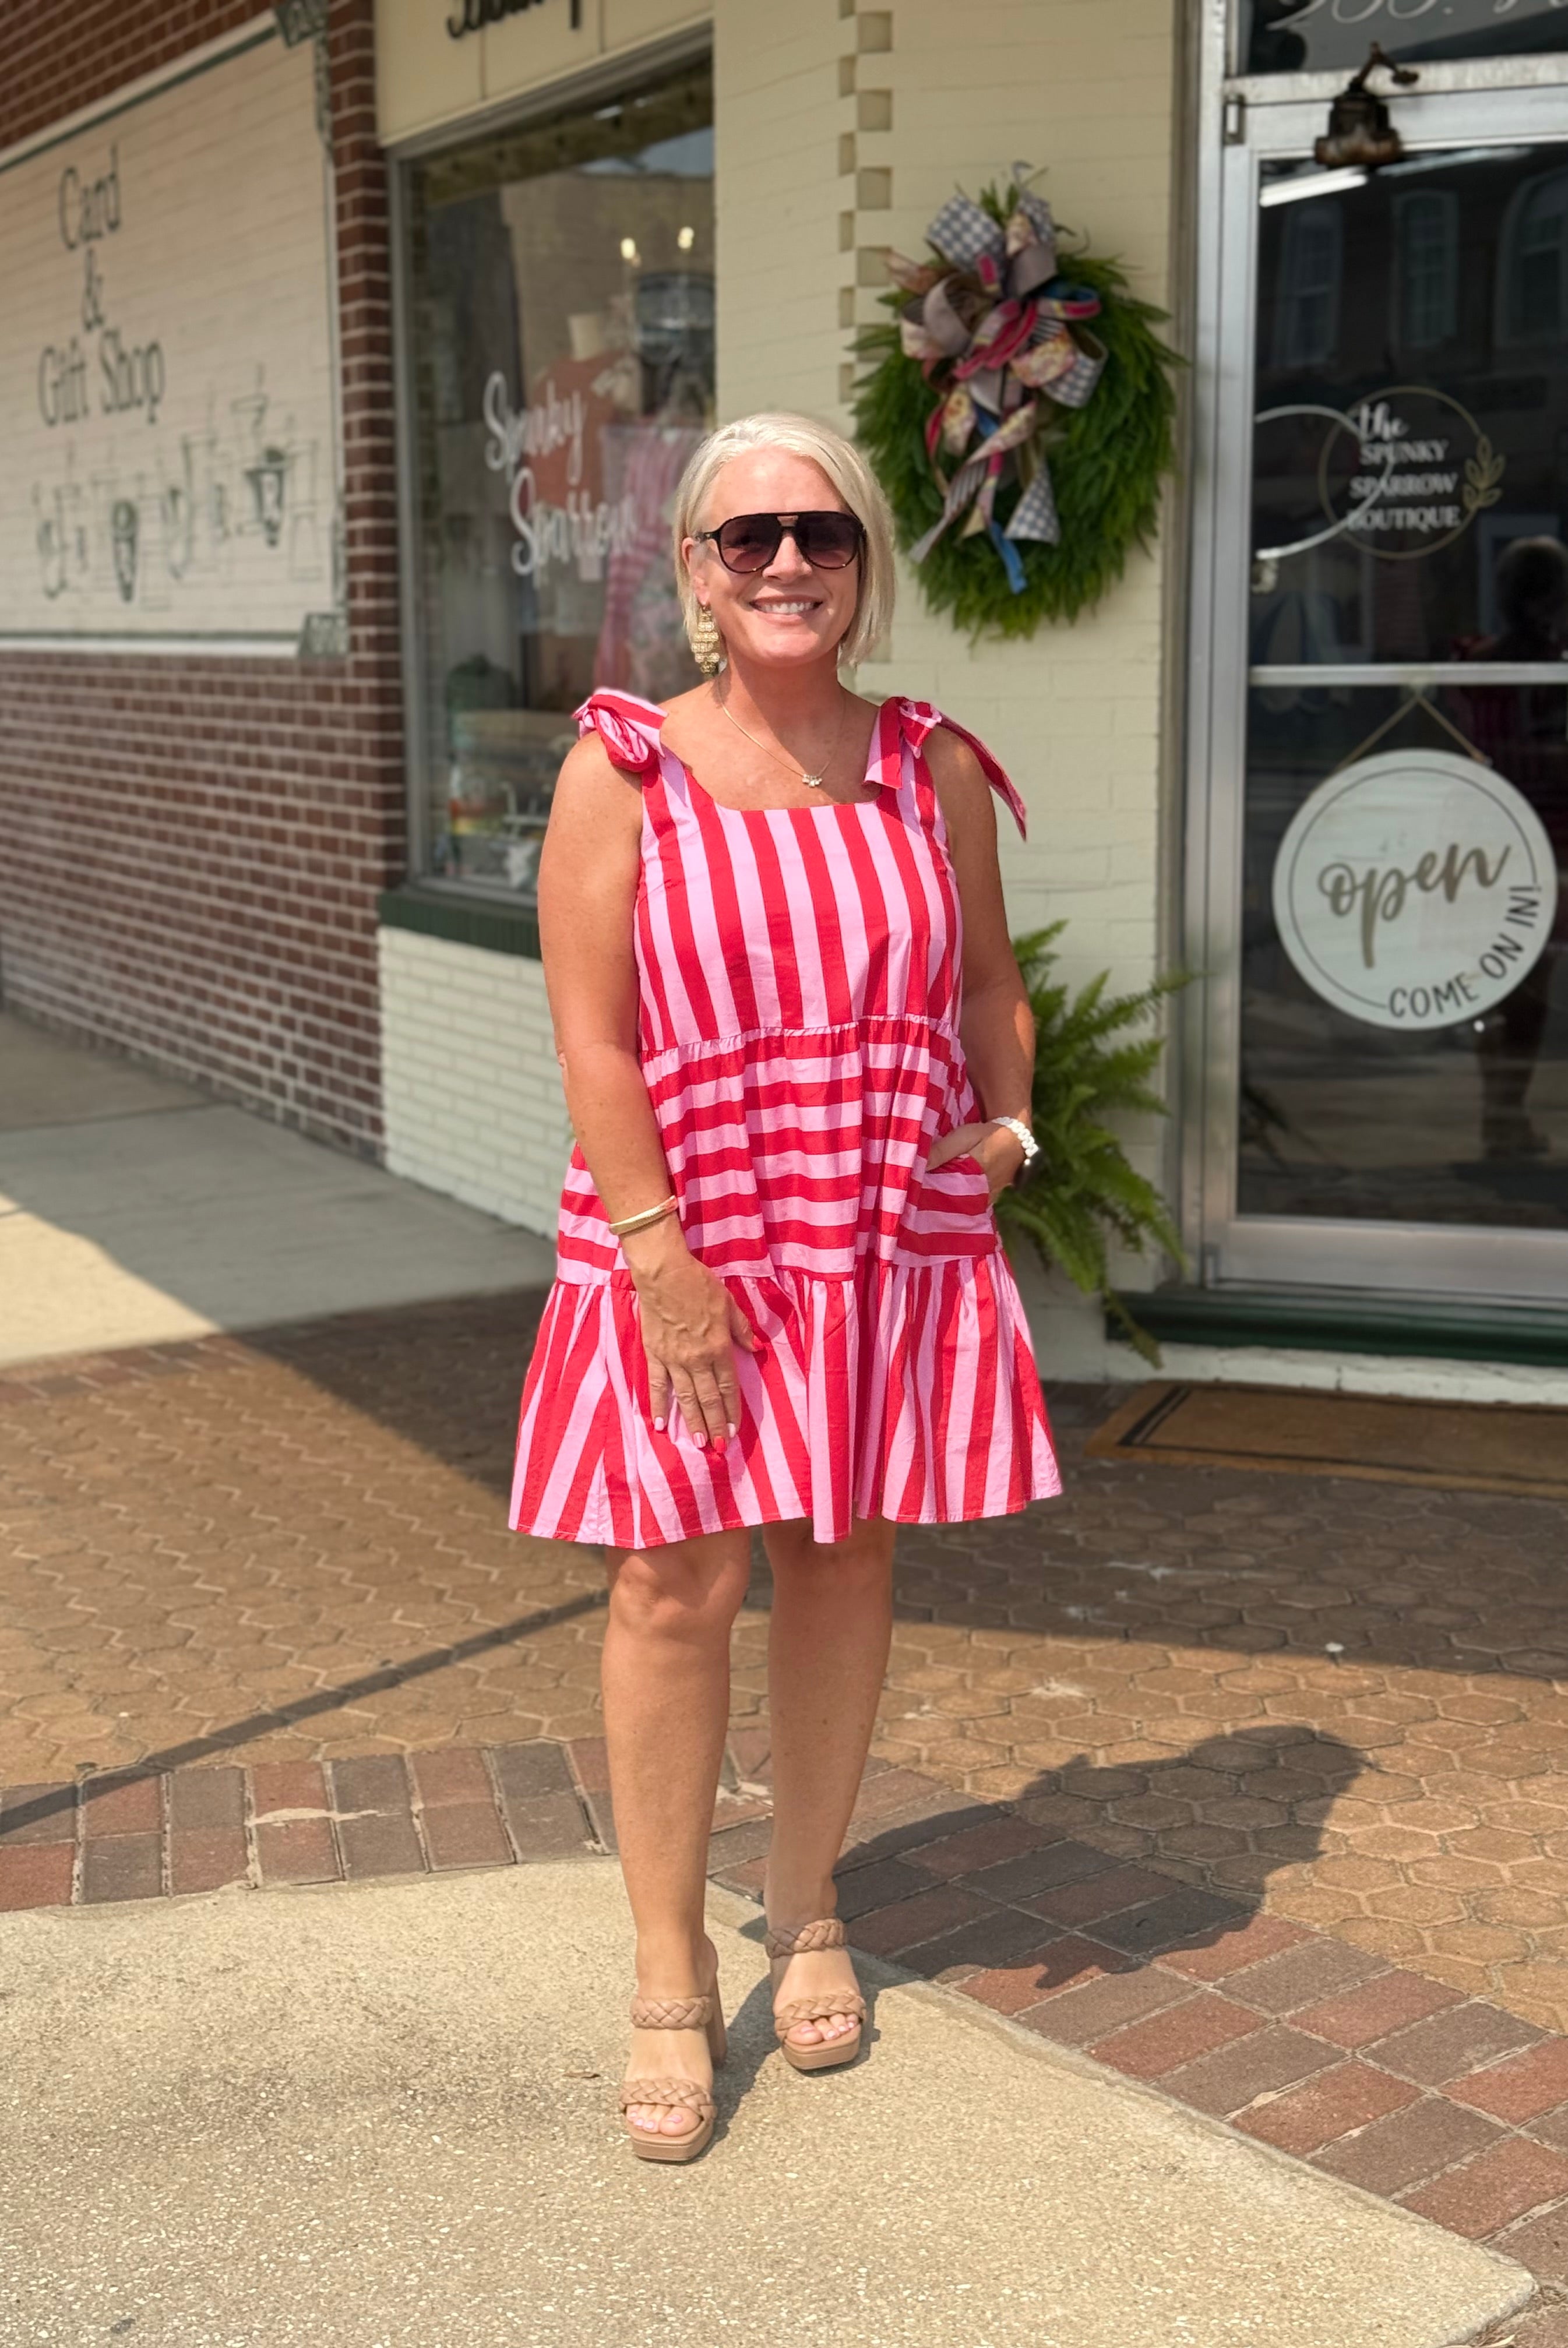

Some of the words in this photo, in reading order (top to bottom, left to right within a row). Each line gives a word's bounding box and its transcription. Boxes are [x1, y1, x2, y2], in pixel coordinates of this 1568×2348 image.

[59, 140, 120, 251] Card
[80, 247, 105, 333] &
[38, 336, 89, 426] Gift
[99, 328, 165, 425] Shop
[1359, 402, 1410, 441] the
[1349, 472, 1458, 499] SPARROW
[1360, 439, 1449, 466] SPUNKY
[1318, 842, 1510, 969] open
[1389, 972, 1478, 1018] COME
[1479, 933, 1524, 980] ON
[1506, 885, 1542, 928] IN!
